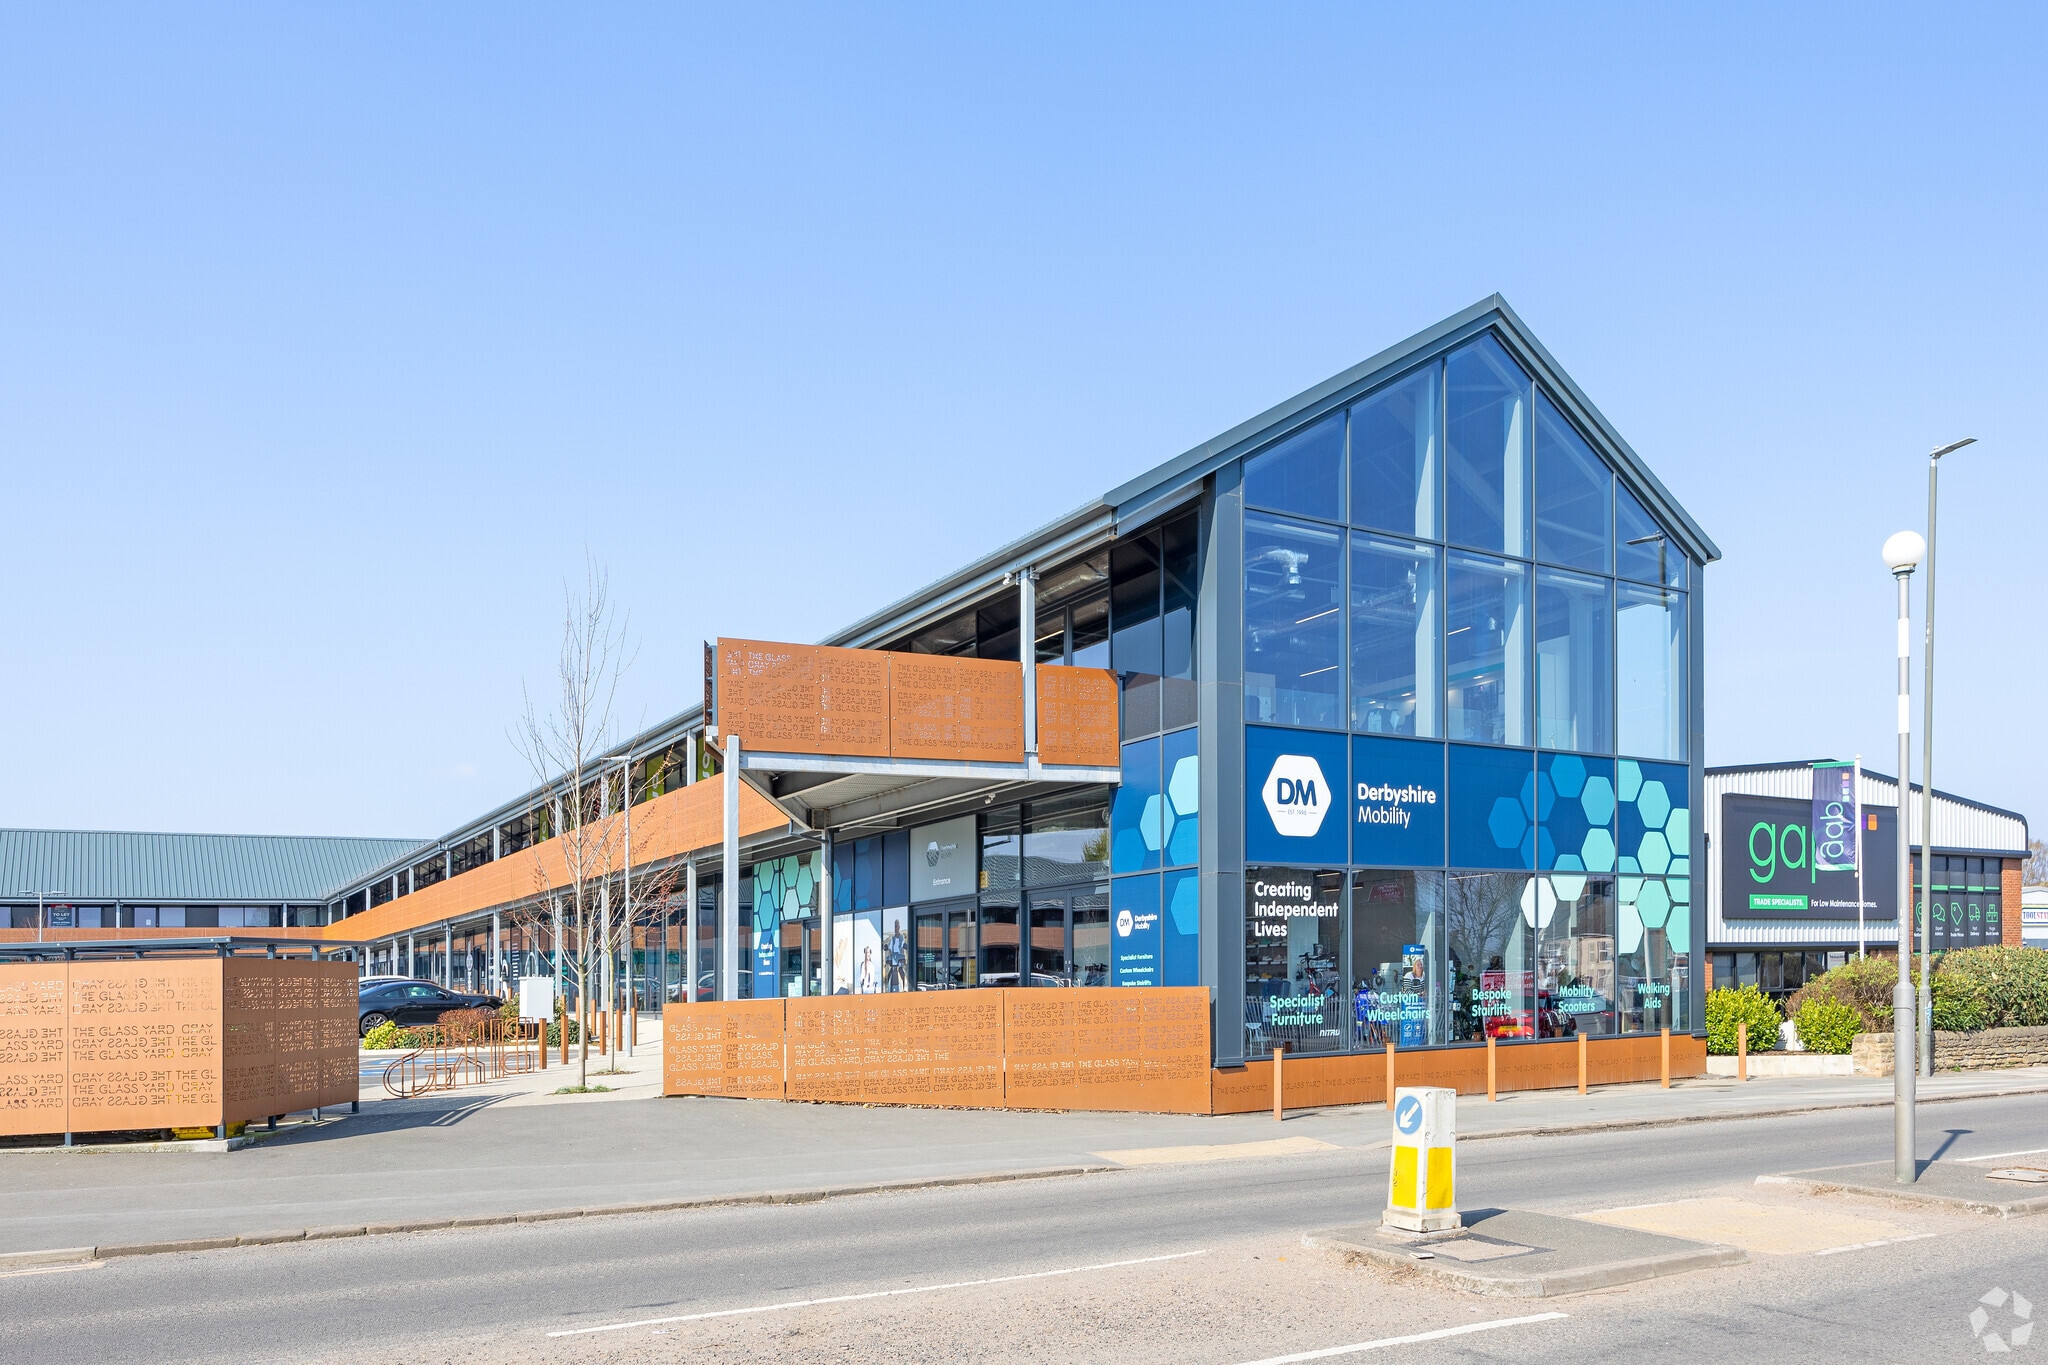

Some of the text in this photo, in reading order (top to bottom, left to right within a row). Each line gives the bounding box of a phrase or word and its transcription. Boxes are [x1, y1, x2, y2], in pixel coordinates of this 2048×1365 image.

[1277, 778, 1317, 806] DM
[1358, 783, 1436, 806] Derbyshire
[1358, 806, 1410, 828] Mobility
[933, 878, 951, 886] Entrance
[1255, 881, 1312, 901] Creating
[1255, 901, 1338, 920] Independent
[1120, 919, 1130, 927] DM
[1255, 922, 1288, 937] Lives
[1472, 988, 1512, 1002] Bespoke
[1560, 985, 1594, 998] Mobility
[1638, 983, 1670, 996] Walking
[1270, 994, 1325, 1011] Specialist
[1380, 992, 1418, 1005] Custom
[1644, 997, 1662, 1009] Aids
[1472, 1005, 1512, 1017] Stairlifts
[1559, 1001, 1595, 1013] Scooters
[1272, 1012, 1323, 1026] Furniture
[1368, 1008, 1431, 1021] Wheelchairs
